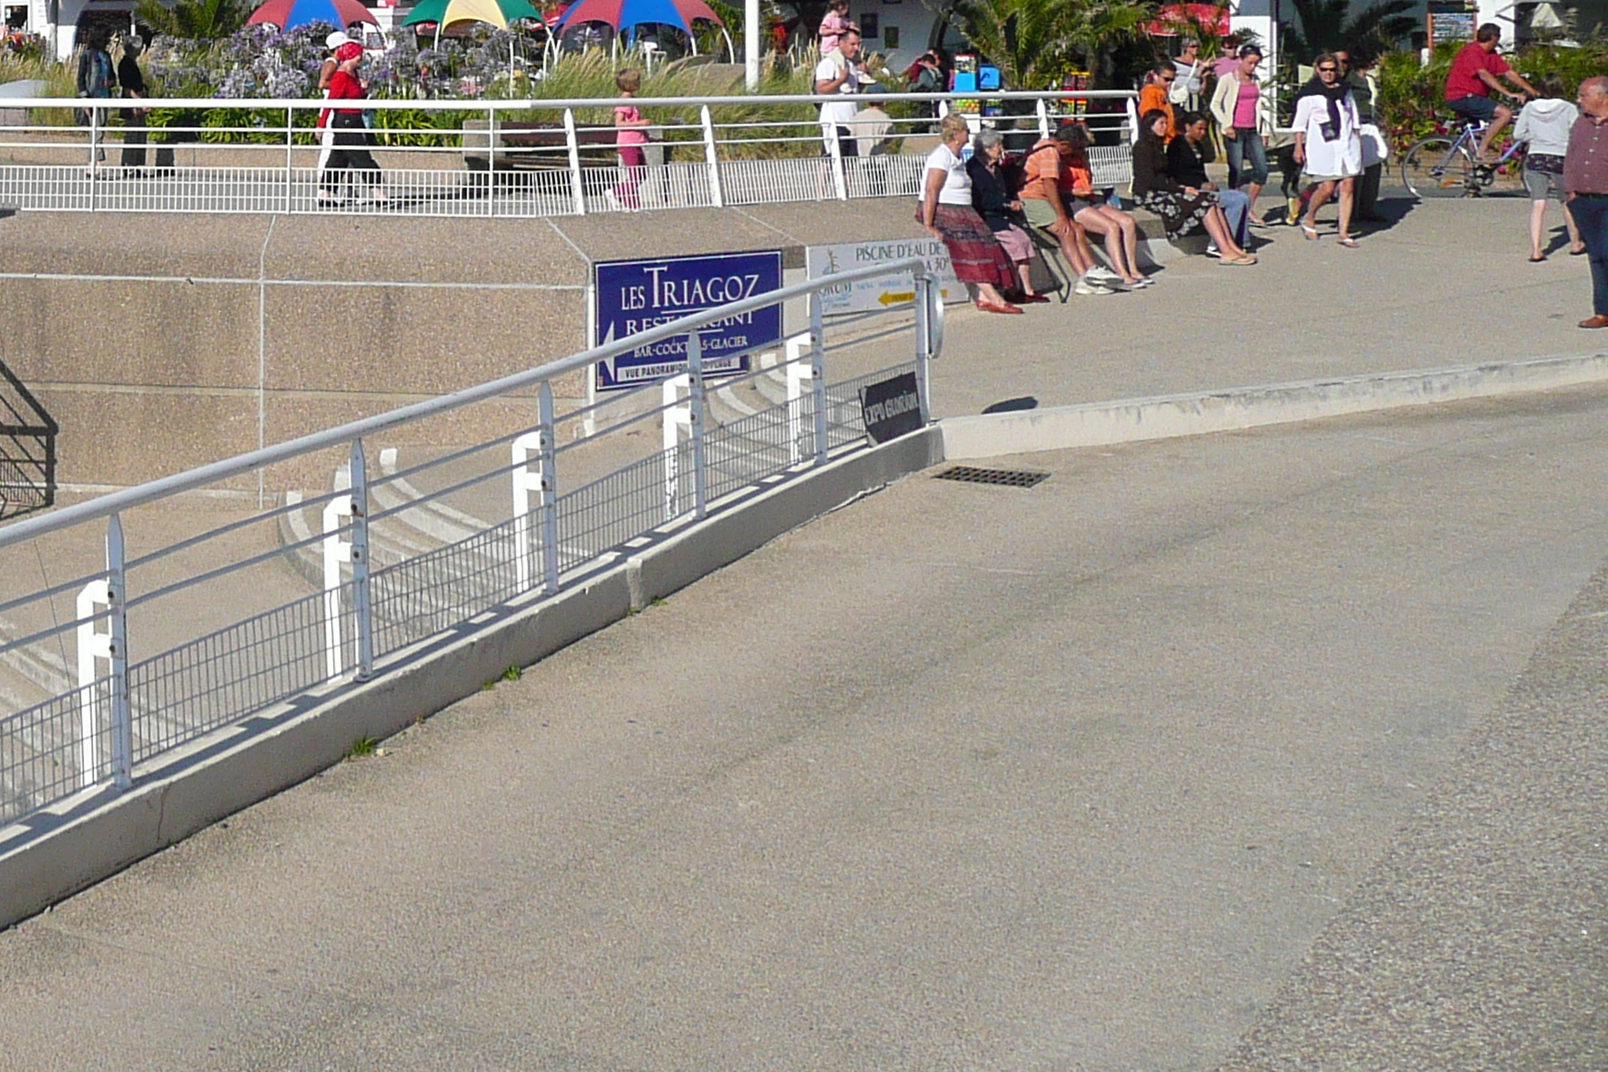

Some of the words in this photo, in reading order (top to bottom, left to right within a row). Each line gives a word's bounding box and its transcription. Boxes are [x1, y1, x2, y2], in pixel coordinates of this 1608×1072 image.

[856, 245, 893, 261] PISCINE
[897, 243, 925, 258] D'EAU
[929, 241, 942, 256] DE
[621, 286, 646, 310] LES
[643, 265, 760, 308] TRIAGOZ
[625, 368, 639, 378] VUE
